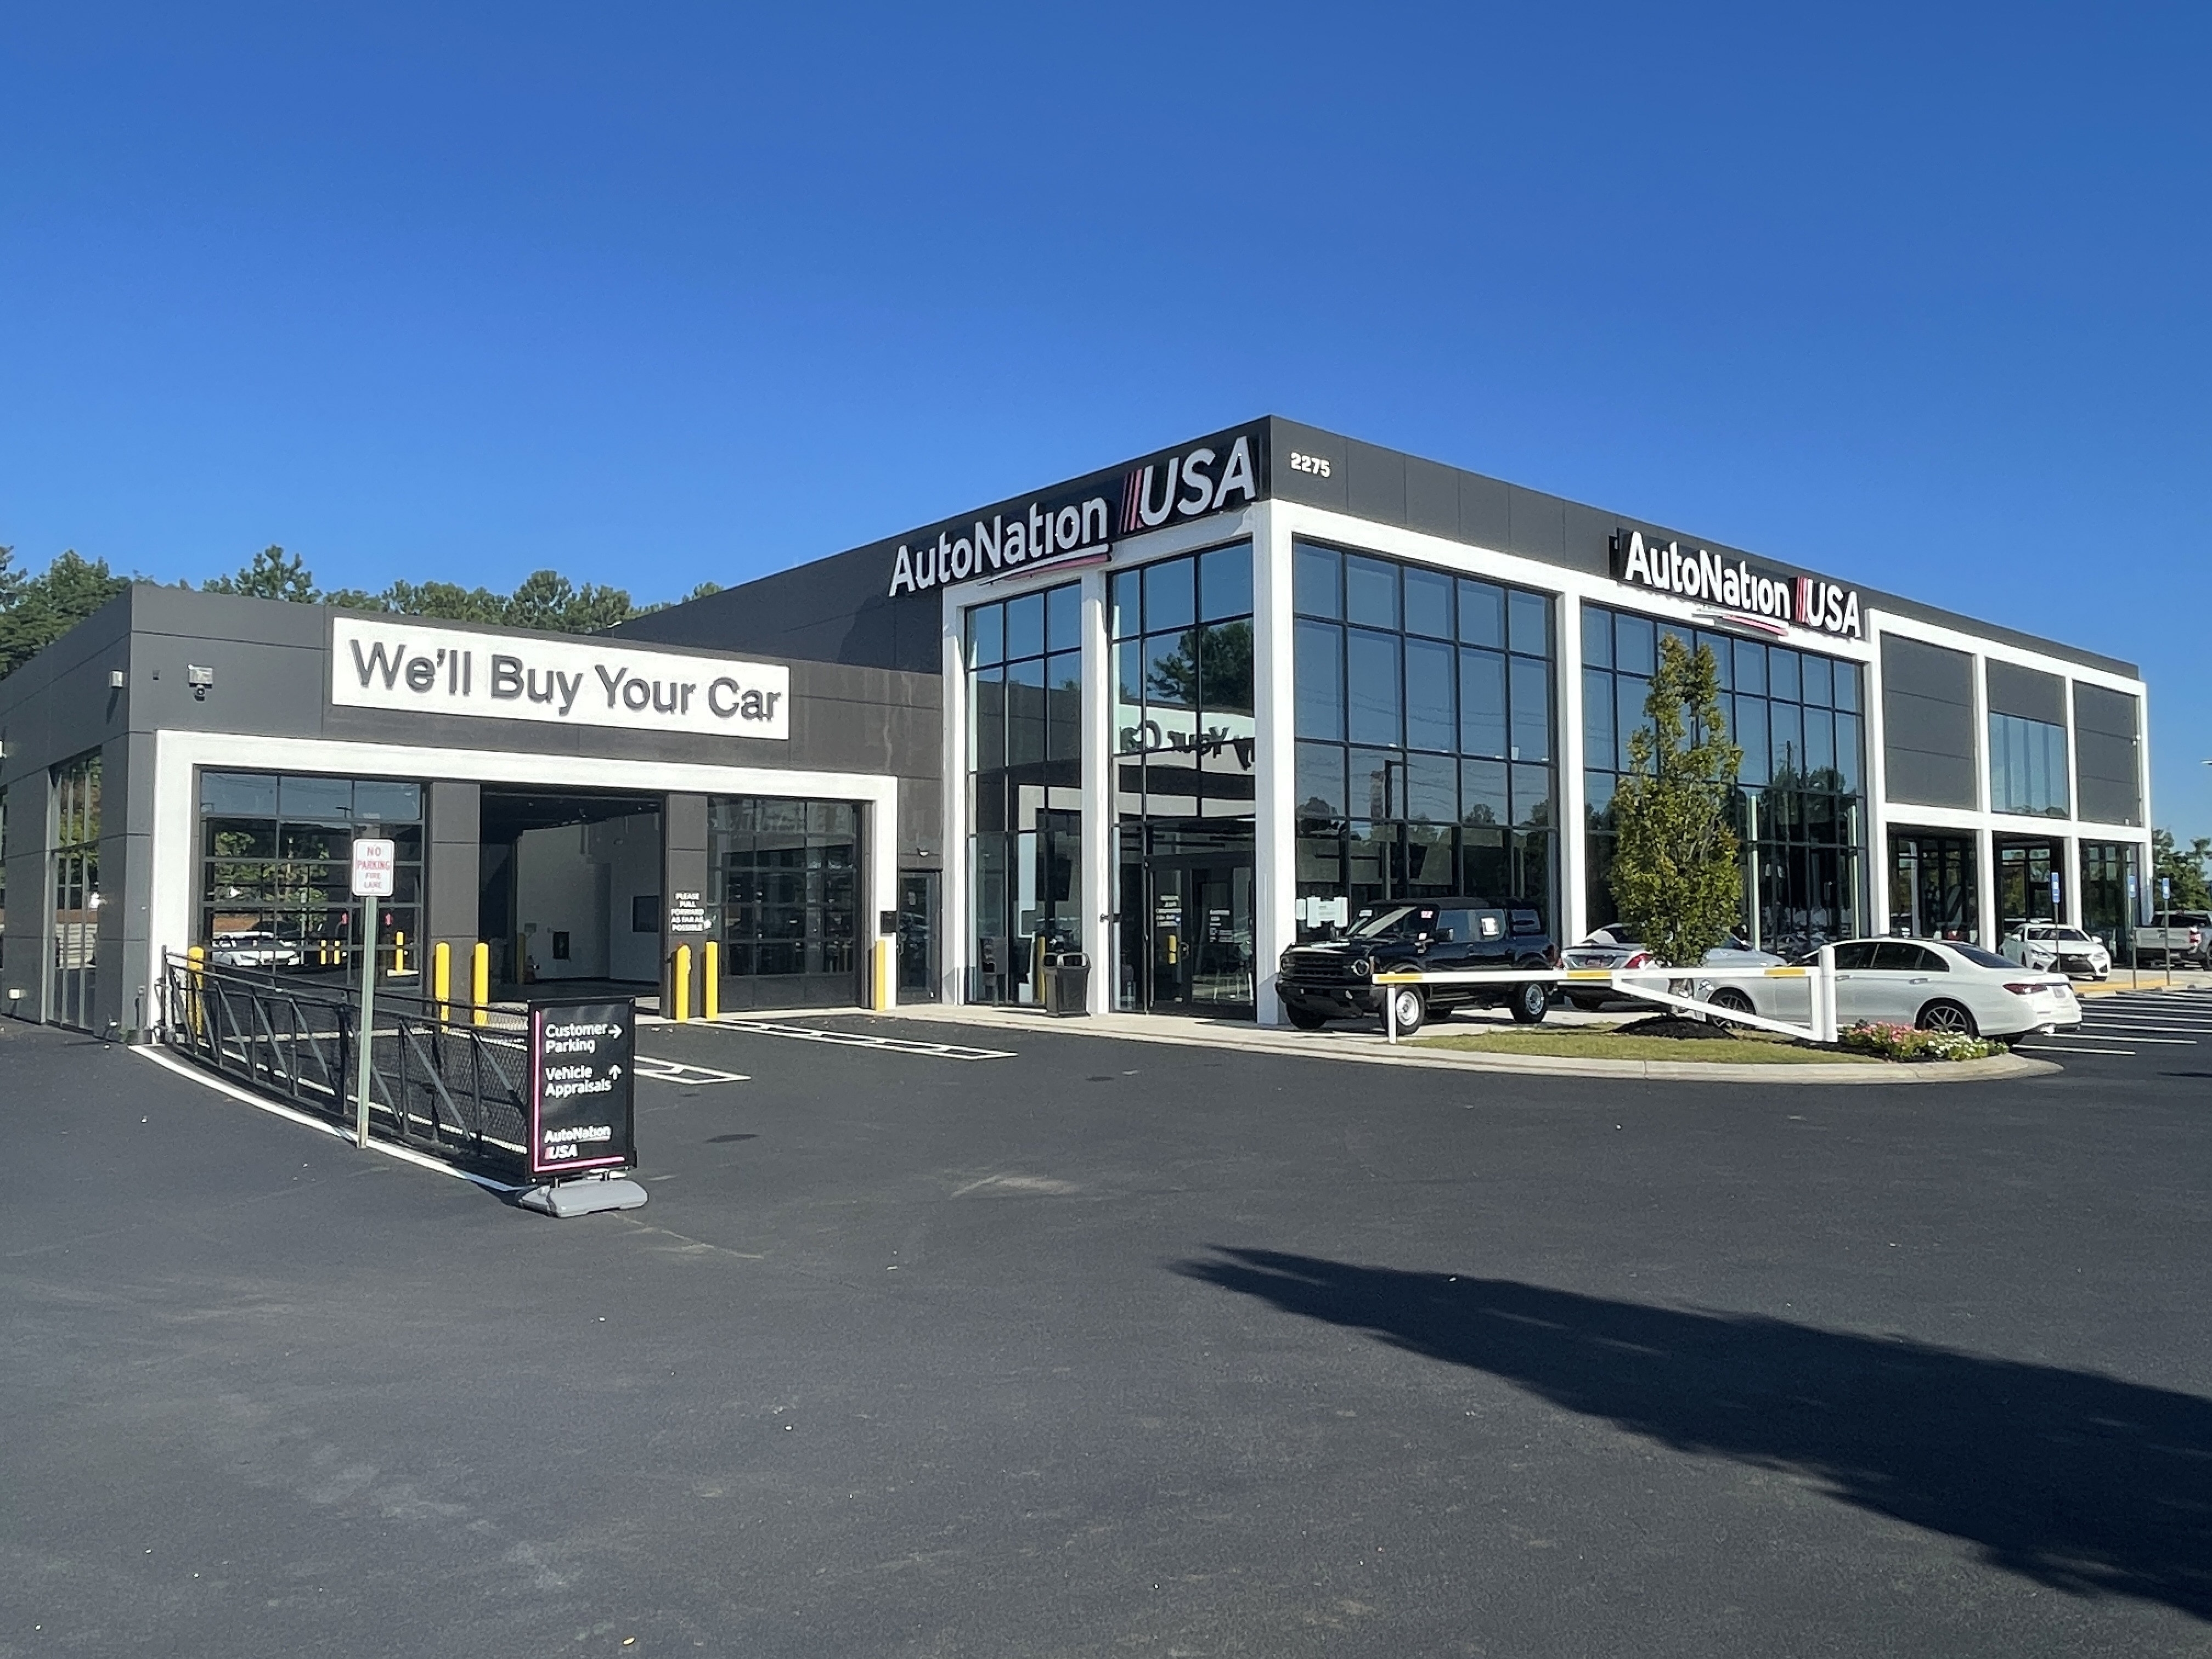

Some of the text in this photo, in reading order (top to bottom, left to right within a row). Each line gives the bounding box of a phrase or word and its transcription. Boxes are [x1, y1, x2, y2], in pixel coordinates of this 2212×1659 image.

[1291, 452, 1331, 477] 2275
[889, 436, 1256, 597] AutoNation USA
[1625, 531, 1862, 639] AutoNation USA
[490, 653, 584, 715] Buy
[595, 663, 696, 715] Your
[707, 676, 781, 721] Car
[366, 847, 382, 856] NO
[356, 860, 391, 871] PARKING
[545, 1023, 609, 1039] Customer
[545, 1039, 596, 1053] Parking
[545, 1064, 593, 1081] Vehicle
[545, 1079, 612, 1098] Appraisals
[544, 1125, 612, 1143] AutoNation
[550, 1144, 578, 1159] USA
